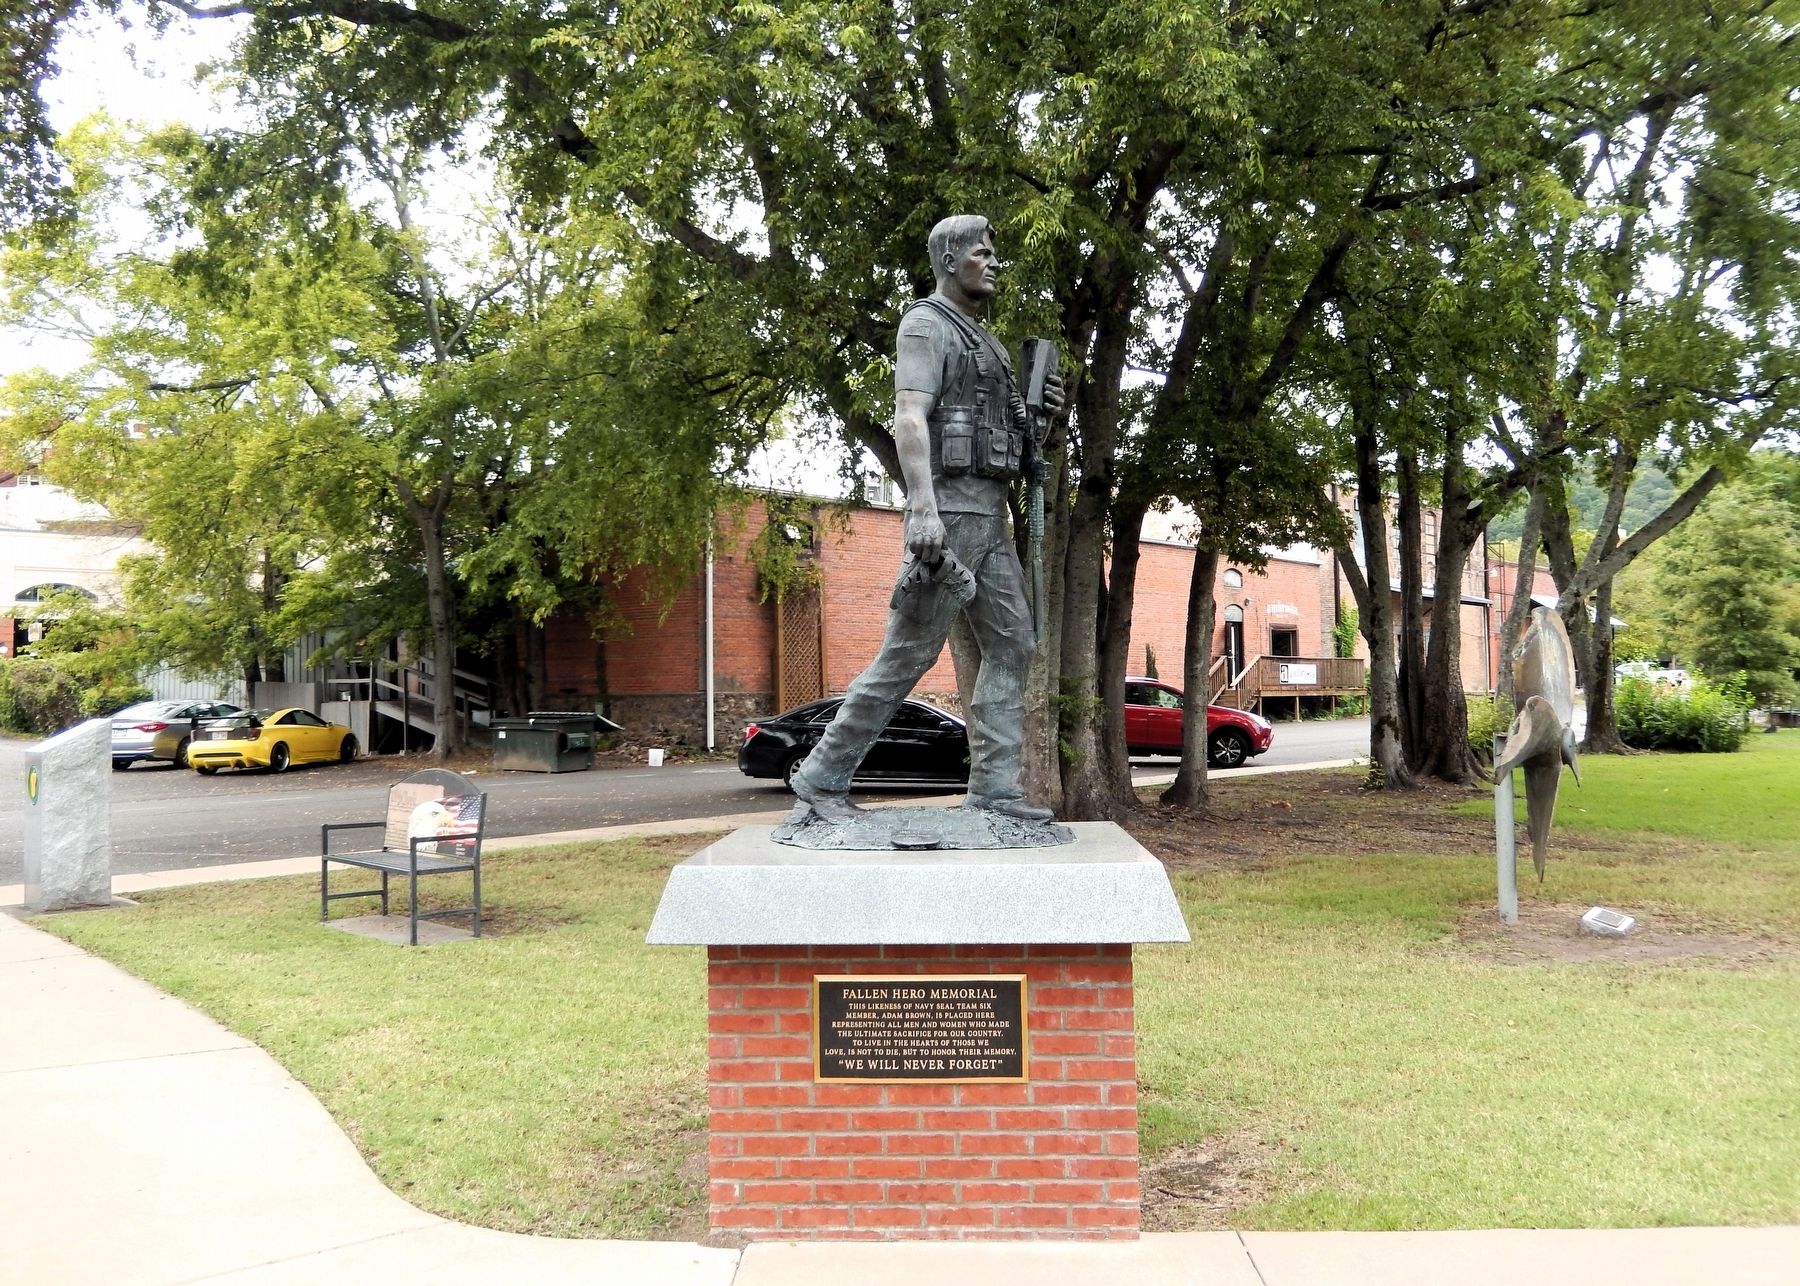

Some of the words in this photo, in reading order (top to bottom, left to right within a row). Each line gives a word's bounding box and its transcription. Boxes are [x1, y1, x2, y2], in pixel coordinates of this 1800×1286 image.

[843, 989, 888, 999] FALLEN
[892, 989, 926, 999] HERO
[930, 989, 997, 999] MEMORIAL
[825, 1048, 846, 1056] LOVE,
[931, 1048, 957, 1056] HONOR
[868, 1059, 899, 1070] WILL
[904, 1059, 945, 1070] NEVER
